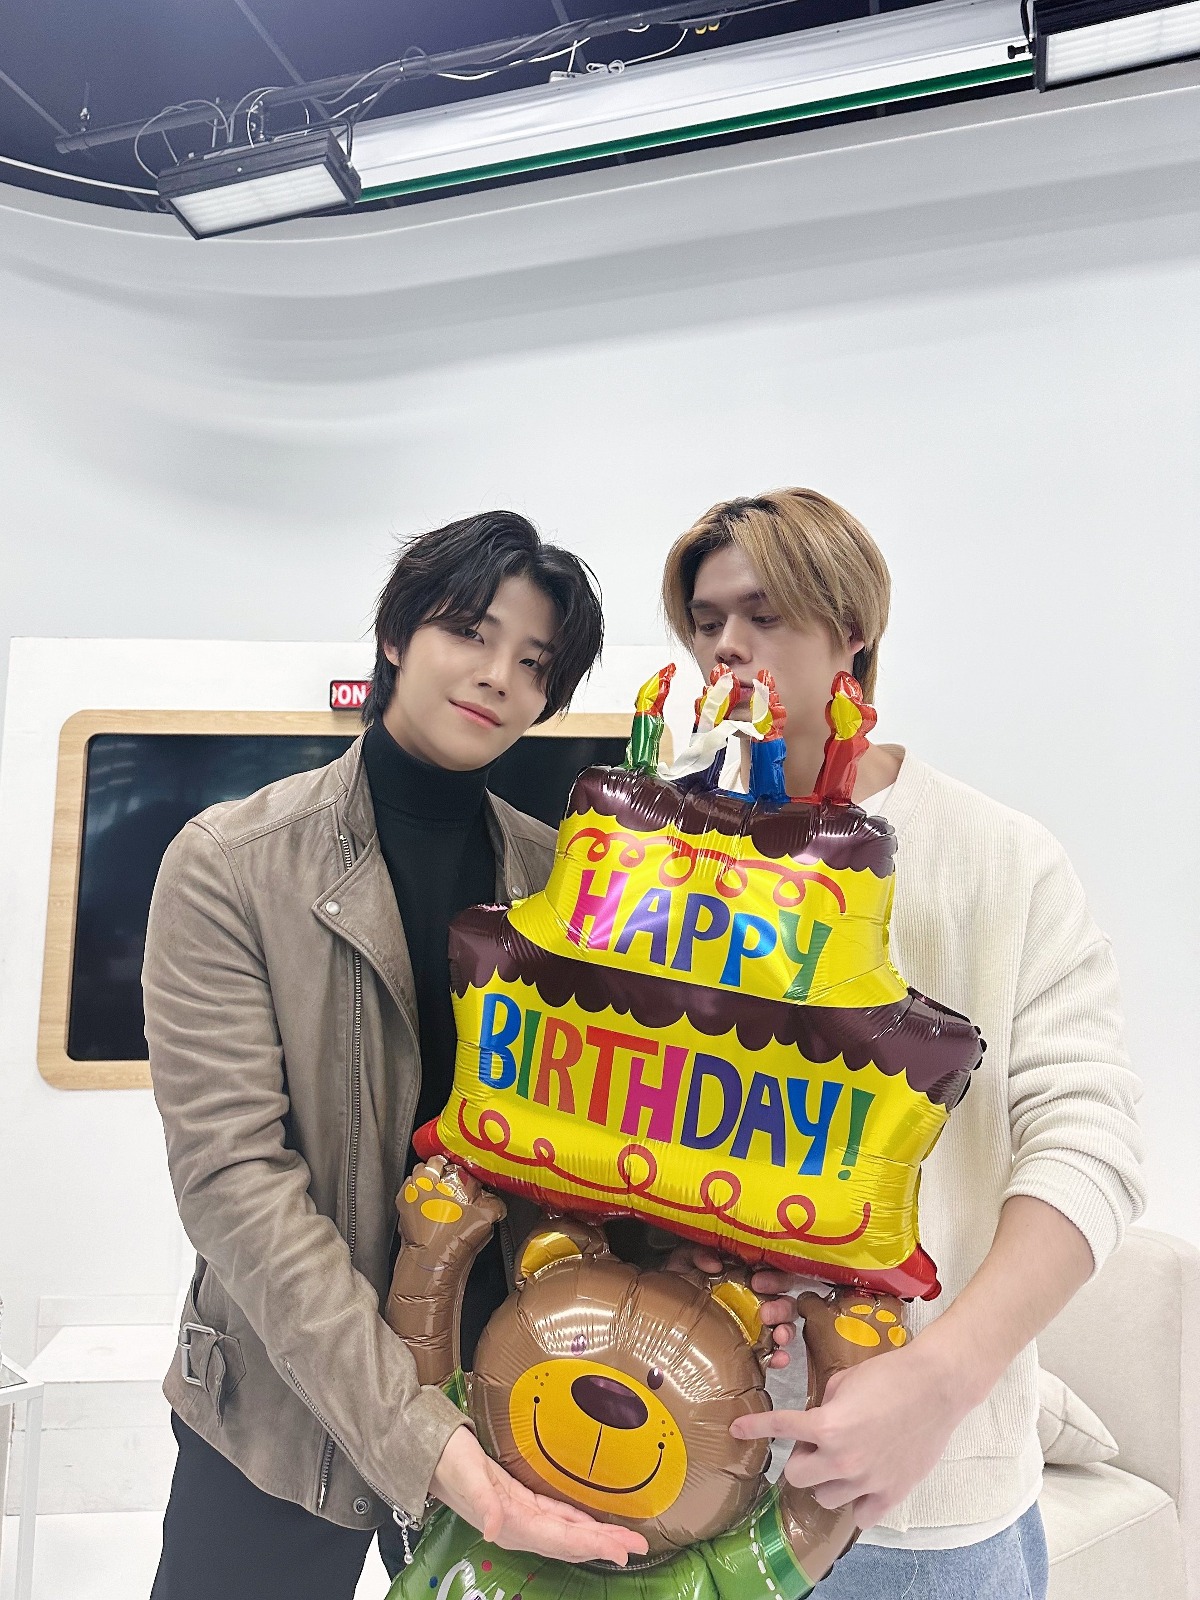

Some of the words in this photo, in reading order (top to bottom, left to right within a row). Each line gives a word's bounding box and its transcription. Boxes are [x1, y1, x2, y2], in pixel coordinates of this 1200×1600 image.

[337, 684, 367, 705] ON
[567, 869, 833, 1000] HAPPY
[479, 993, 875, 1180] BIRTHDAY!
